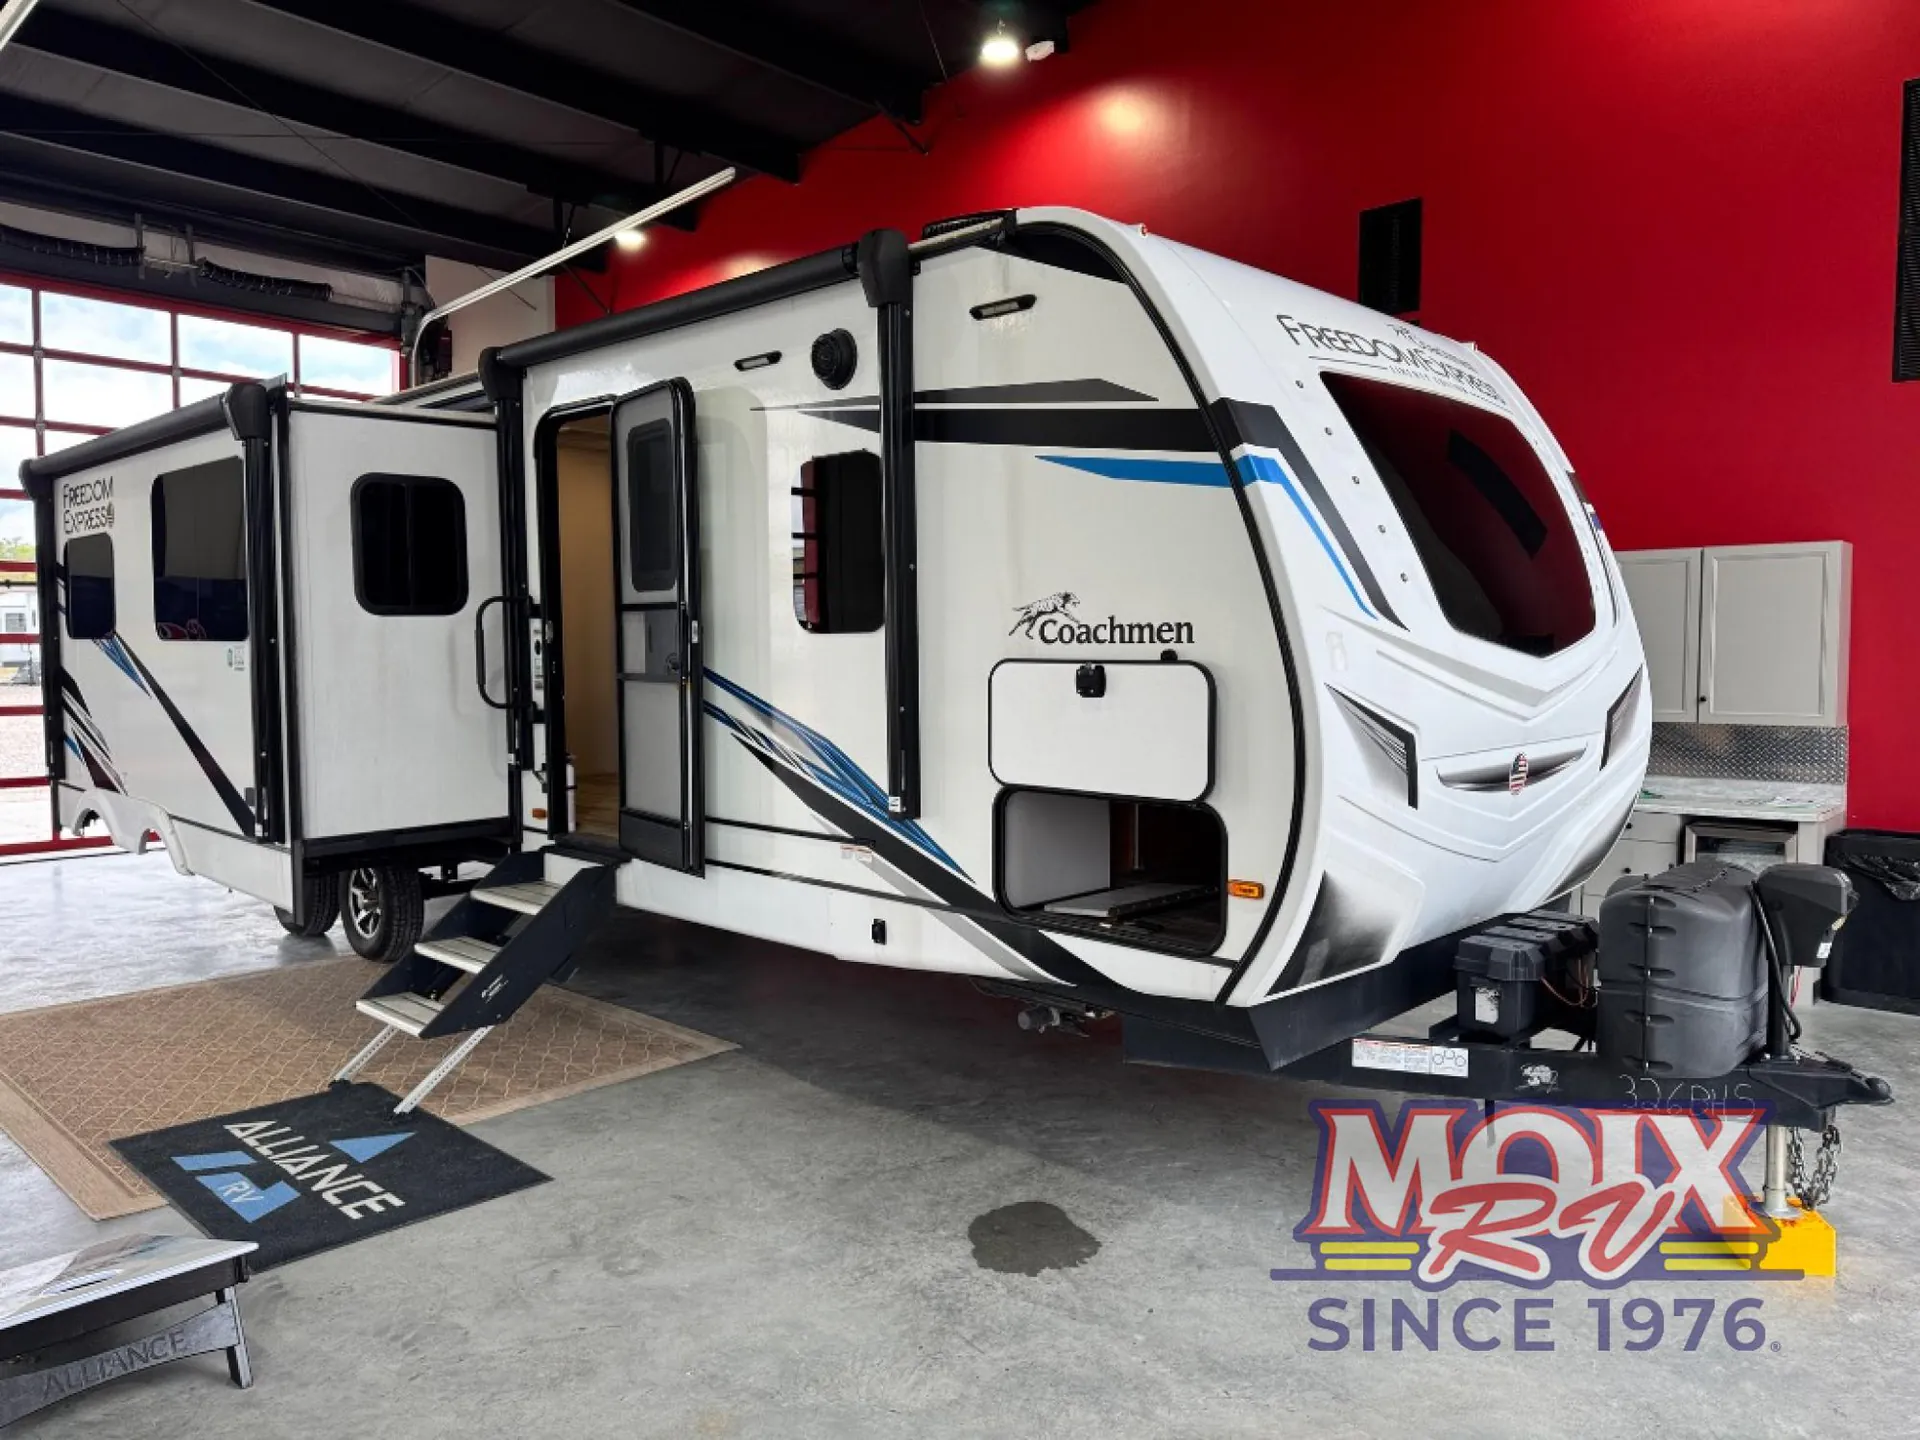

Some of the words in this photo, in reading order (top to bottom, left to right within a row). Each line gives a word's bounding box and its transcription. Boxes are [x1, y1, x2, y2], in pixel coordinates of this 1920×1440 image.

[1275, 313, 1420, 371] FREEDOM
[63, 475, 114, 510] FREEDOM
[63, 504, 107, 535] EXPRESS
[1038, 614, 1195, 645] Coachmen
[222, 1119, 406, 1221] ALLIANCE
[216, 1180, 266, 1205] RV
[41, 1327, 188, 1401] ALLIANCE
